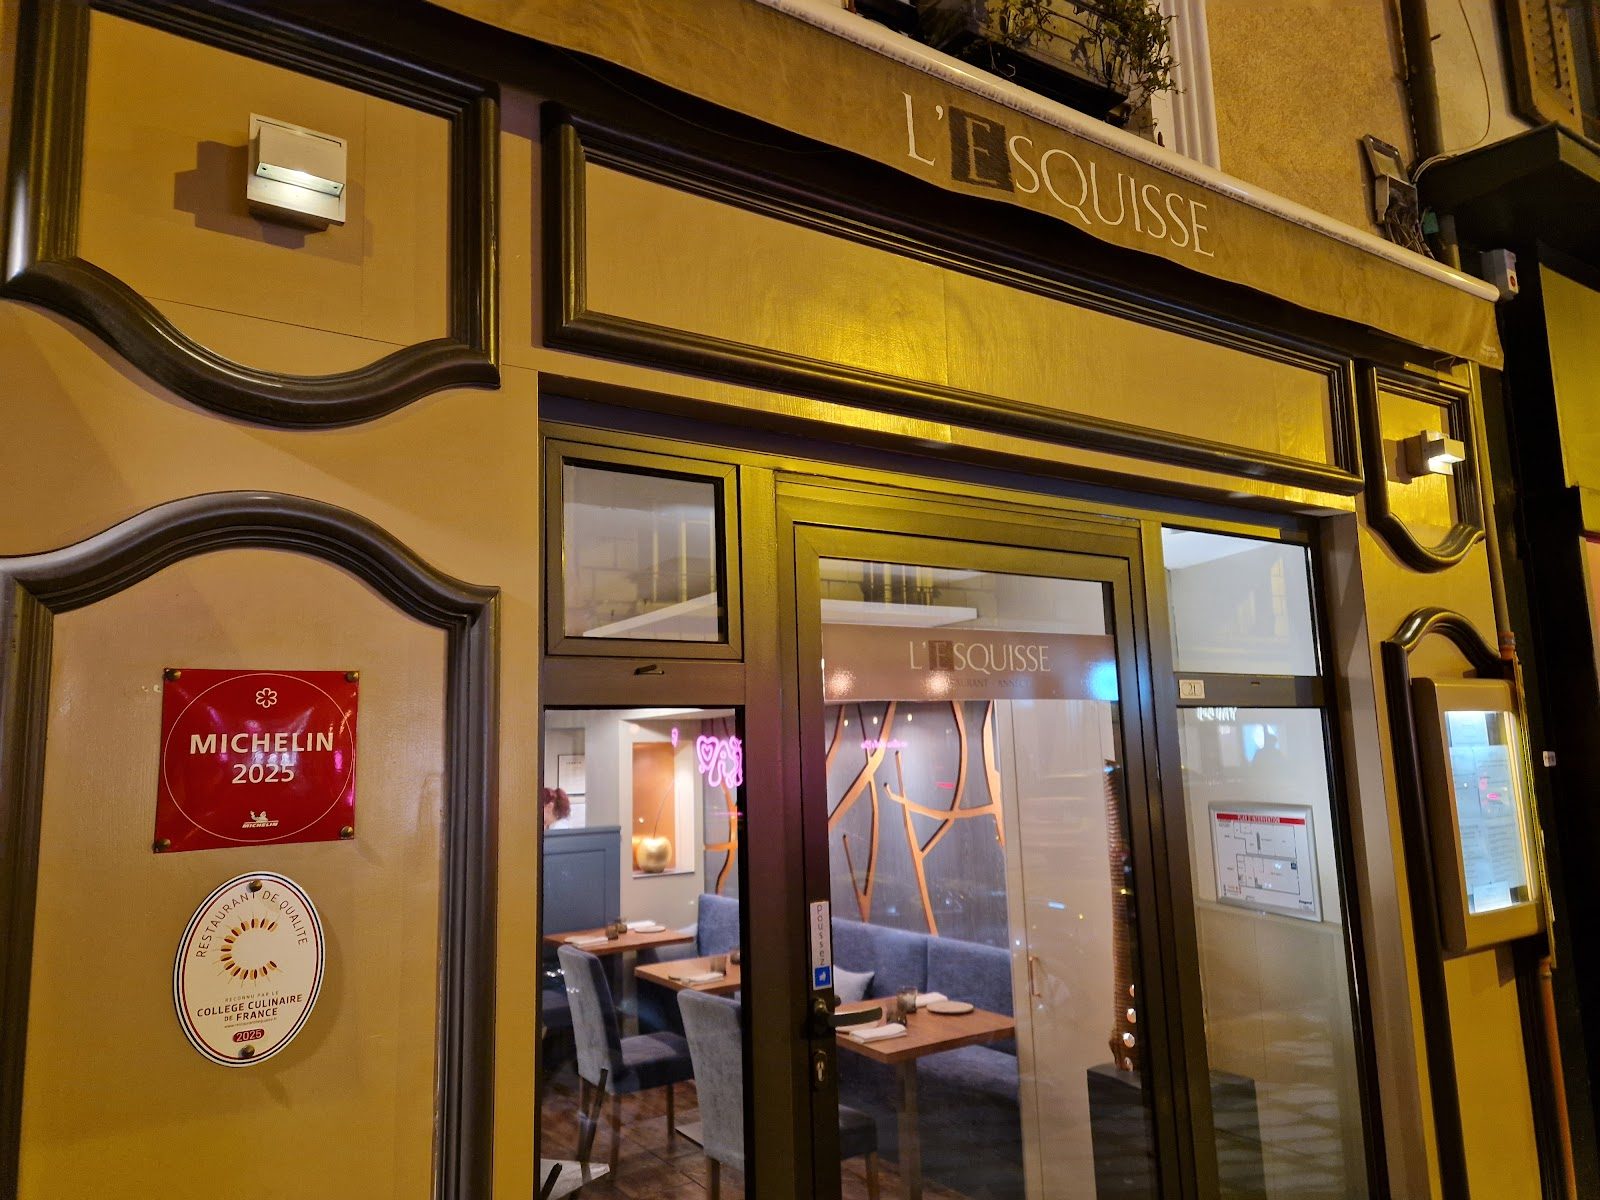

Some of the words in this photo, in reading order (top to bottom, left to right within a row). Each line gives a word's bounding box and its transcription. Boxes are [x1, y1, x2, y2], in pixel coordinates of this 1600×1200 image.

[902, 91, 1215, 258] L'ESQUISSE
[909, 641, 1051, 675] L'ESQUISSE
[190, 732, 334, 755] MICHELIN
[231, 763, 295, 784] 2025
[195, 892, 256, 958] RESTAURANT
[262, 890, 280, 903] DE
[816, 904, 825, 966] poussez
[197, 1002, 245, 1017] COLLEGE
[247, 994, 303, 1010] CULINAIRE
[236, 1007, 278, 1021] FRANCE
[236, 1030, 262, 1041] 2025
